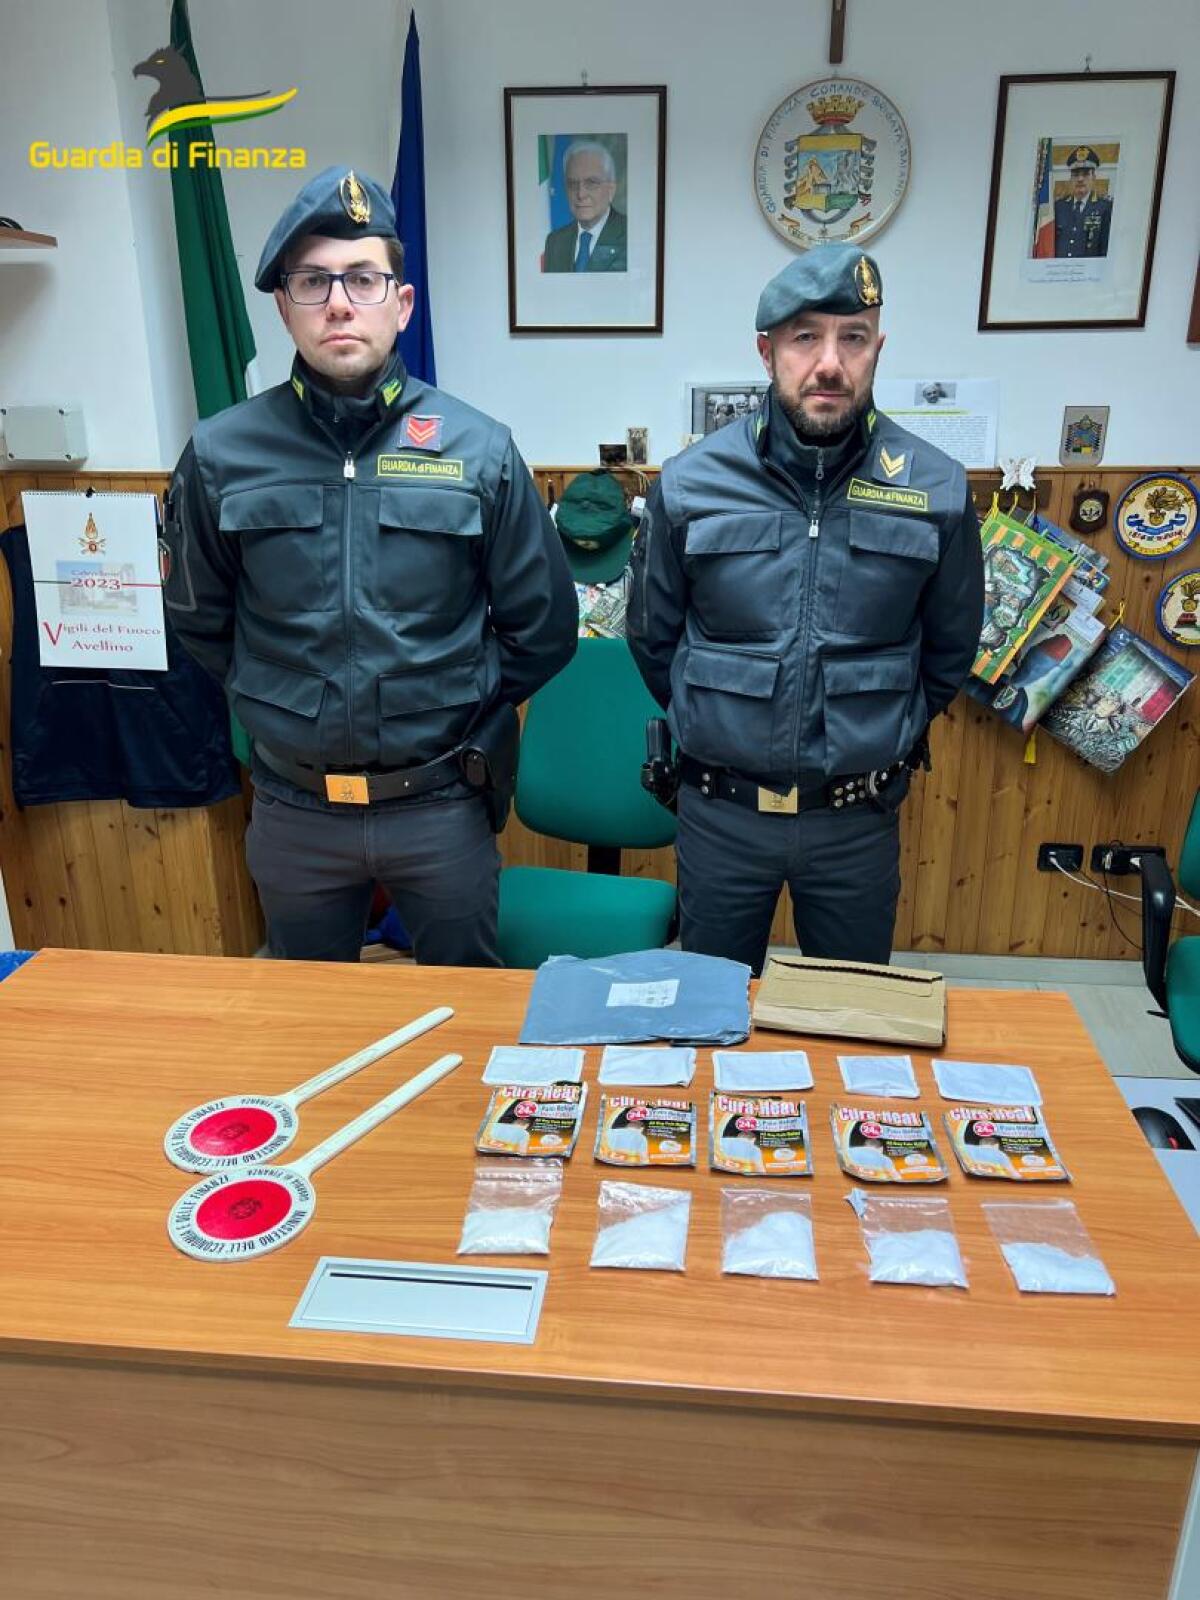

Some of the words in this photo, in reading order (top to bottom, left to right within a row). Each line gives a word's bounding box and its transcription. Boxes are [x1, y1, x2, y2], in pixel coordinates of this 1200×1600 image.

[760, 146, 770, 158] DI
[809, 83, 869, 98] COMANDO
[381, 459, 417, 473] GUARDIA
[424, 463, 459, 475] FINANZA
[852, 485, 884, 499] GUARDIA
[891, 492, 924, 506] FINANZA
[71, 578, 121, 591] 2023
[43, 621, 88, 646] Vigili
[92, 624, 113, 634] del
[117, 626, 162, 635] Fuoco
[71, 640, 134, 652] Avellino
[190, 1175, 229, 1199] FINANZE
